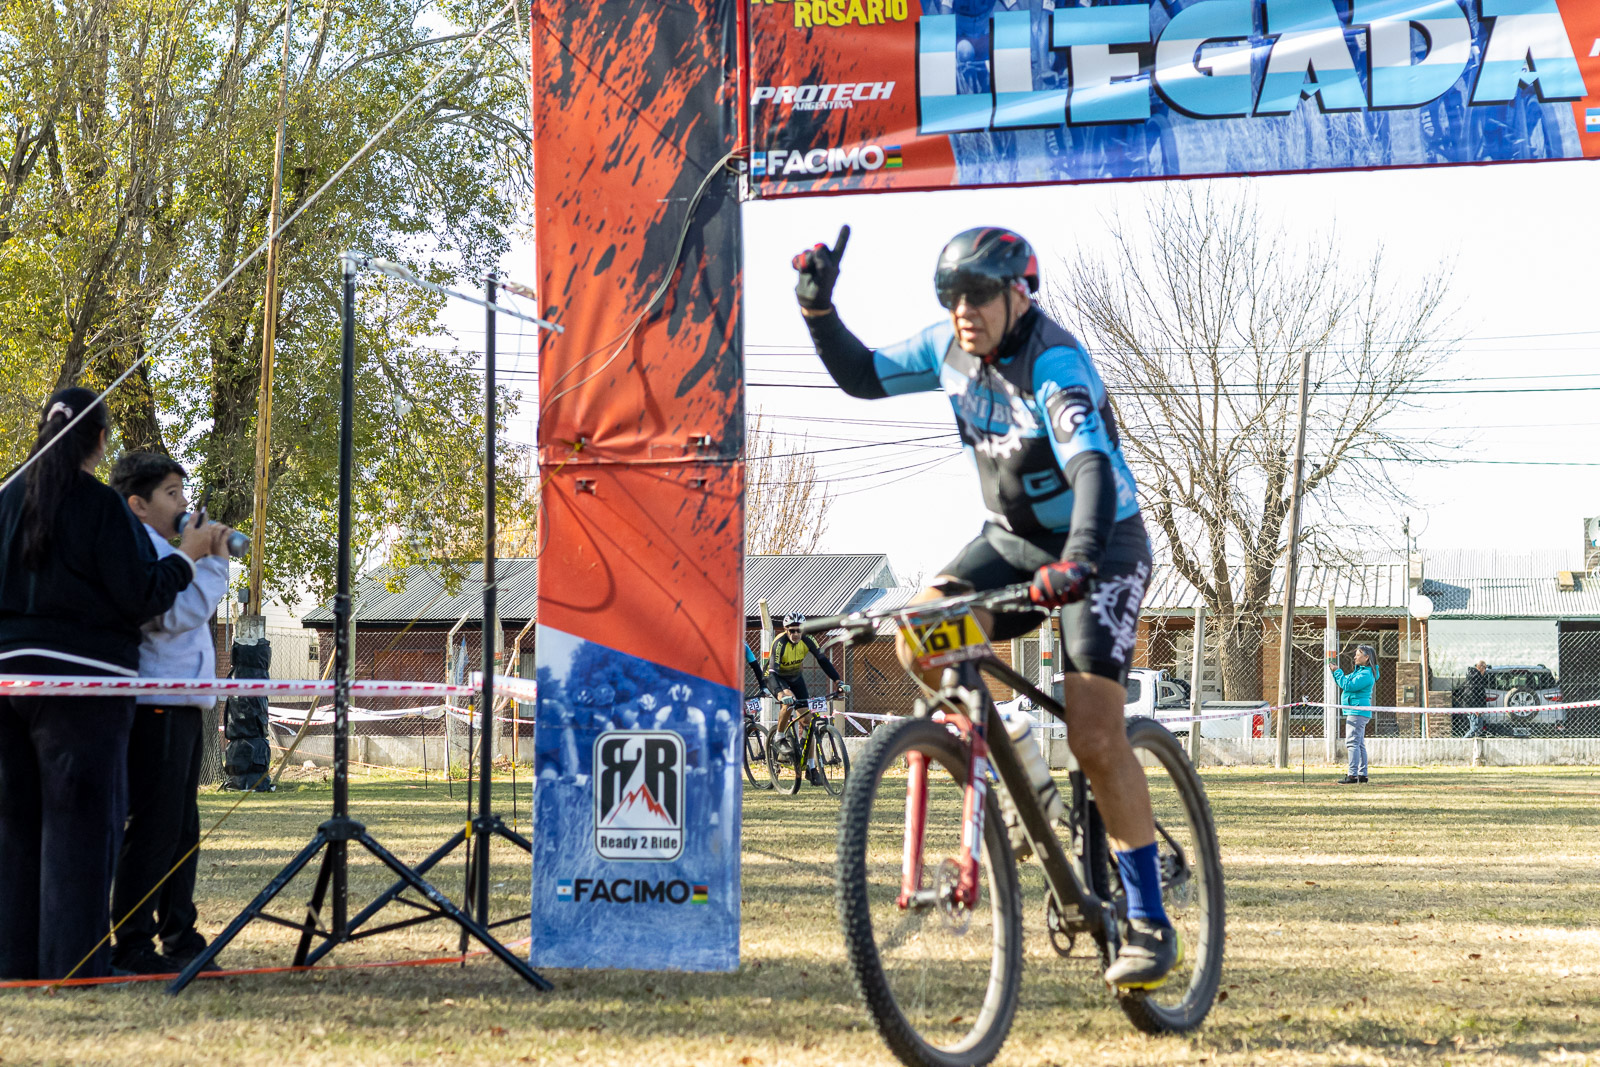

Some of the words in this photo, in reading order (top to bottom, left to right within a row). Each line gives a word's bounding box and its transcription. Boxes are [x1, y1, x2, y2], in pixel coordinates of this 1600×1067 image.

[794, 0, 908, 28] ROSARIO
[917, 0, 1588, 135] LLEGADA
[750, 81, 896, 105] PROTECH
[791, 100, 854, 111] ARGENTINA
[767, 145, 885, 175] FACIMO
[812, 700, 824, 710] 65
[600, 835, 638, 850] Ready
[640, 836, 648, 849] 2
[651, 836, 678, 849] Ride
[574, 878, 690, 904] FACIMO
